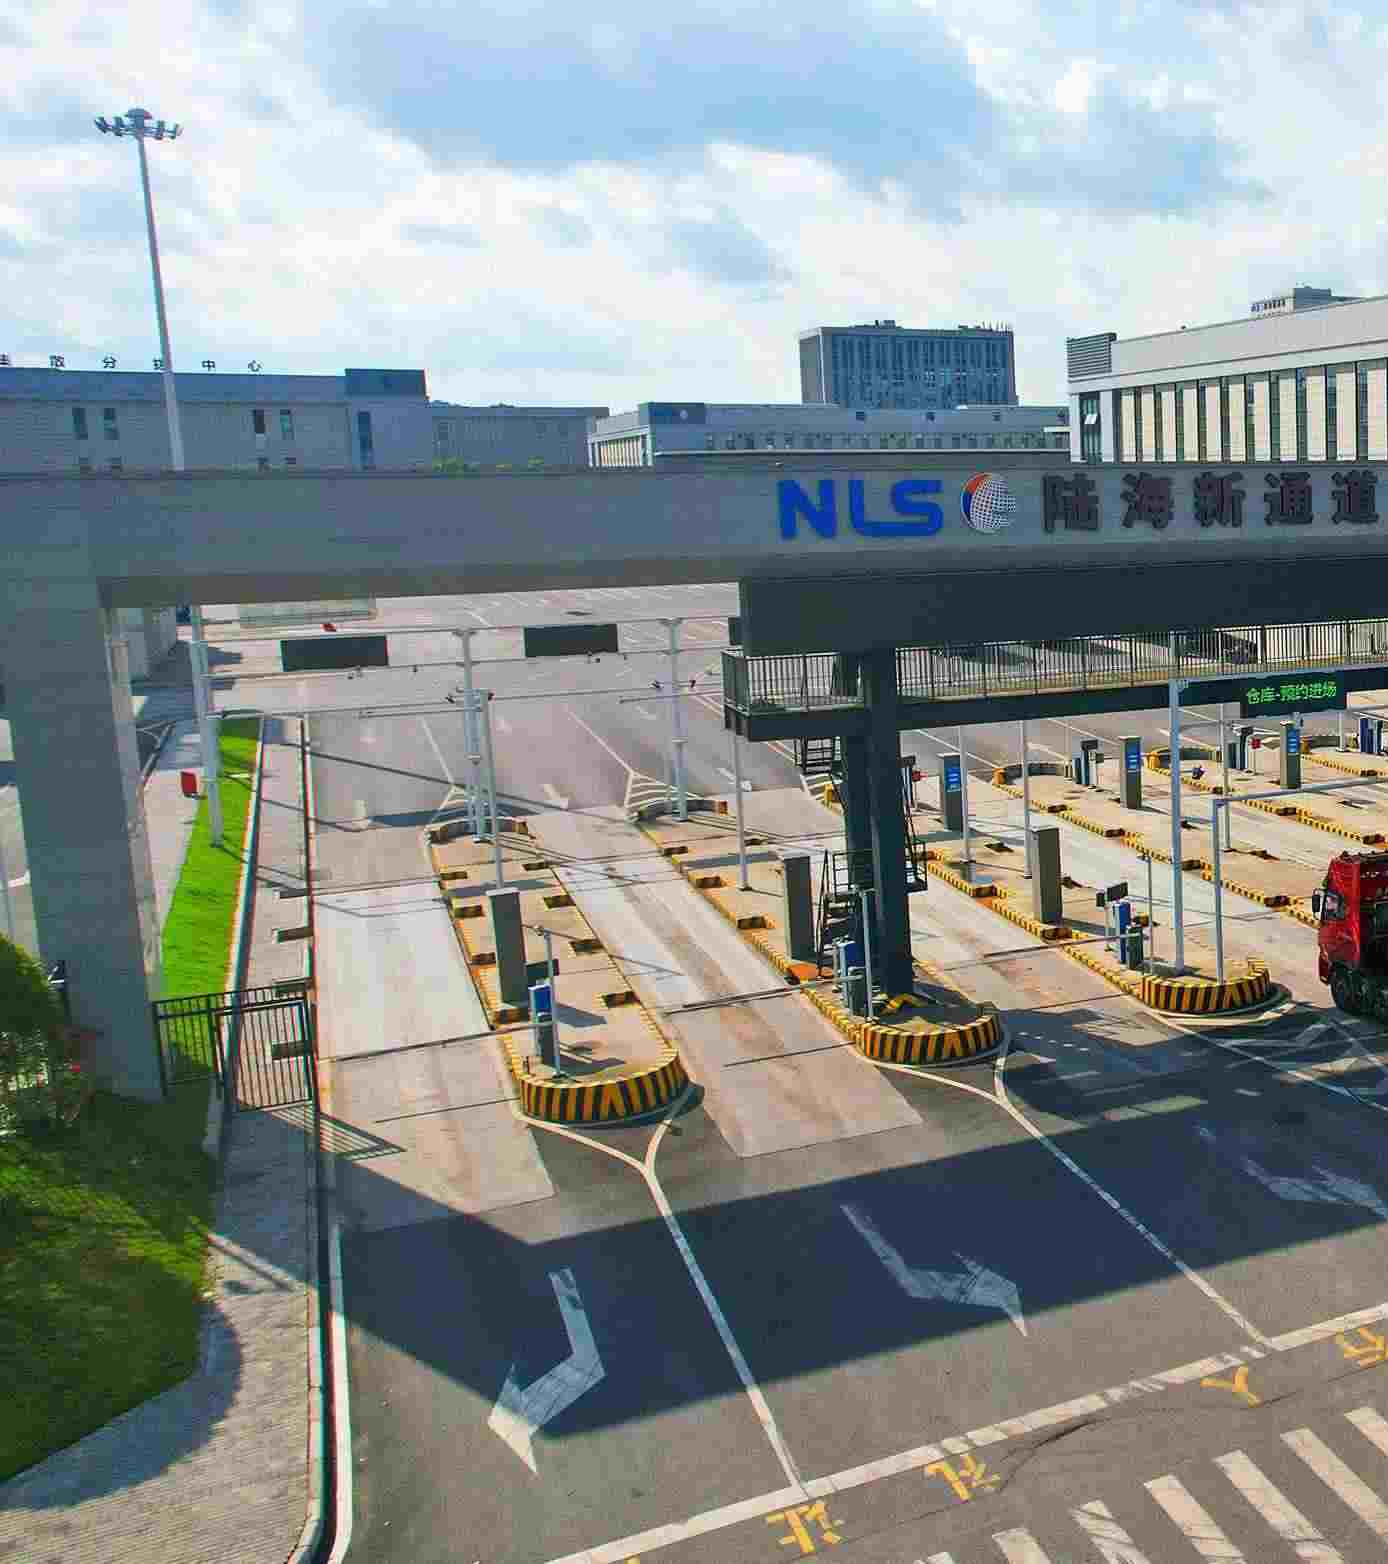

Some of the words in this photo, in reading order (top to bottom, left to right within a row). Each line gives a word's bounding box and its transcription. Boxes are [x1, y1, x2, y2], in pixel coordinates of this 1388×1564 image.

[777, 479, 944, 540] NLS
[1246, 680, 1337, 704] 仓库-预约进场
